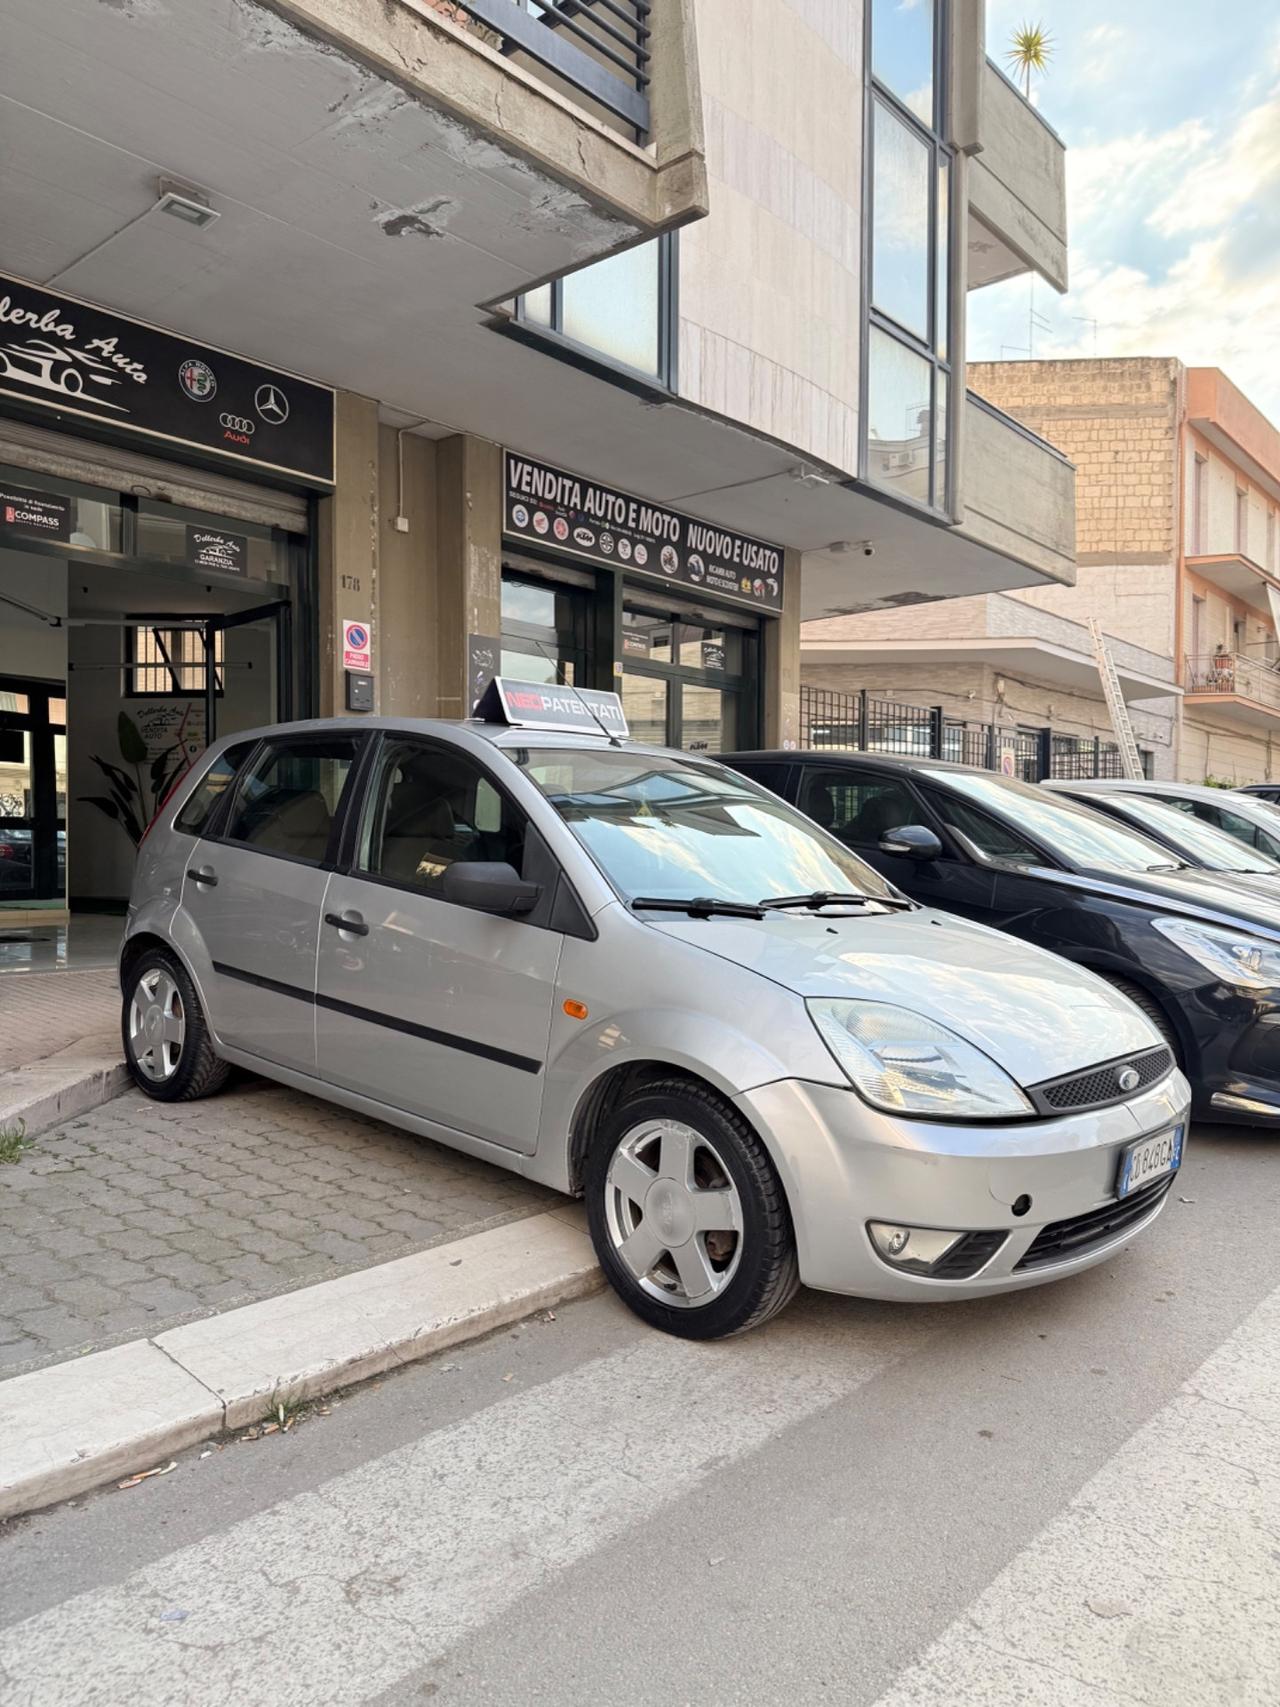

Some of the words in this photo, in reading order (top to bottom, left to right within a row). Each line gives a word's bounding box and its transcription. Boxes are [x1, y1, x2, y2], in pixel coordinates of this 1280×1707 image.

[84, 337, 148, 384] Auto
[224, 431, 250, 445] Audi
[509, 459, 581, 510] VENDITA
[584, 487, 626, 524] AUTO
[628, 502, 638, 528] E
[639, 506, 681, 542] MOTO
[15, 510, 59, 526] COMPASS
[575, 530, 593, 543] KTM
[687, 523, 732, 560] NUOVO
[733, 539, 742, 563] E
[742, 542, 779, 575] USATO
[200, 554, 233, 566] GARANZIA
[342, 574, 360, 592] 178
